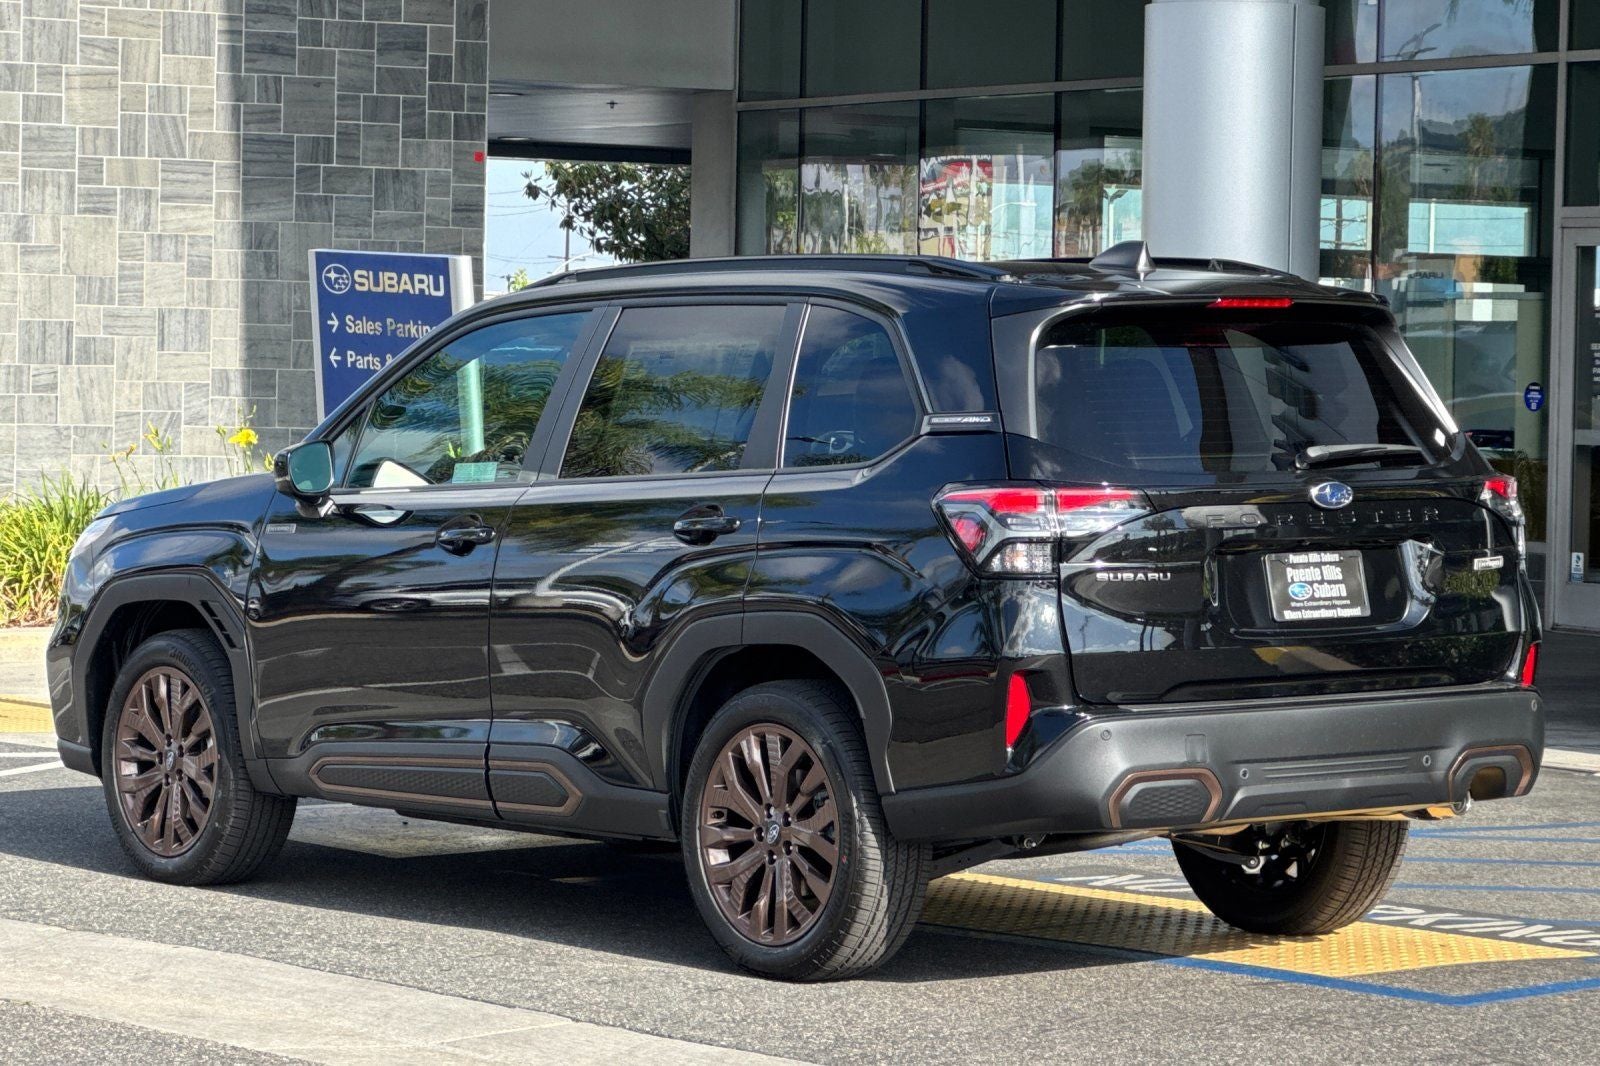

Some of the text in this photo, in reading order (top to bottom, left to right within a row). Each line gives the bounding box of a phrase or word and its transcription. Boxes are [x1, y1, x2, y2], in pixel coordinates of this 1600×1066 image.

[354, 269, 444, 296] SUBARU
[345, 315, 382, 336] Sales
[347, 351, 381, 370] Parts
[1206, 508, 1439, 528] FORESTER
[1289, 554, 1308, 563] Puente
[1096, 572, 1171, 581] SUBARU
[1286, 564, 1343, 582] Puente Hills
[1313, 583, 1347, 598] Subaru
